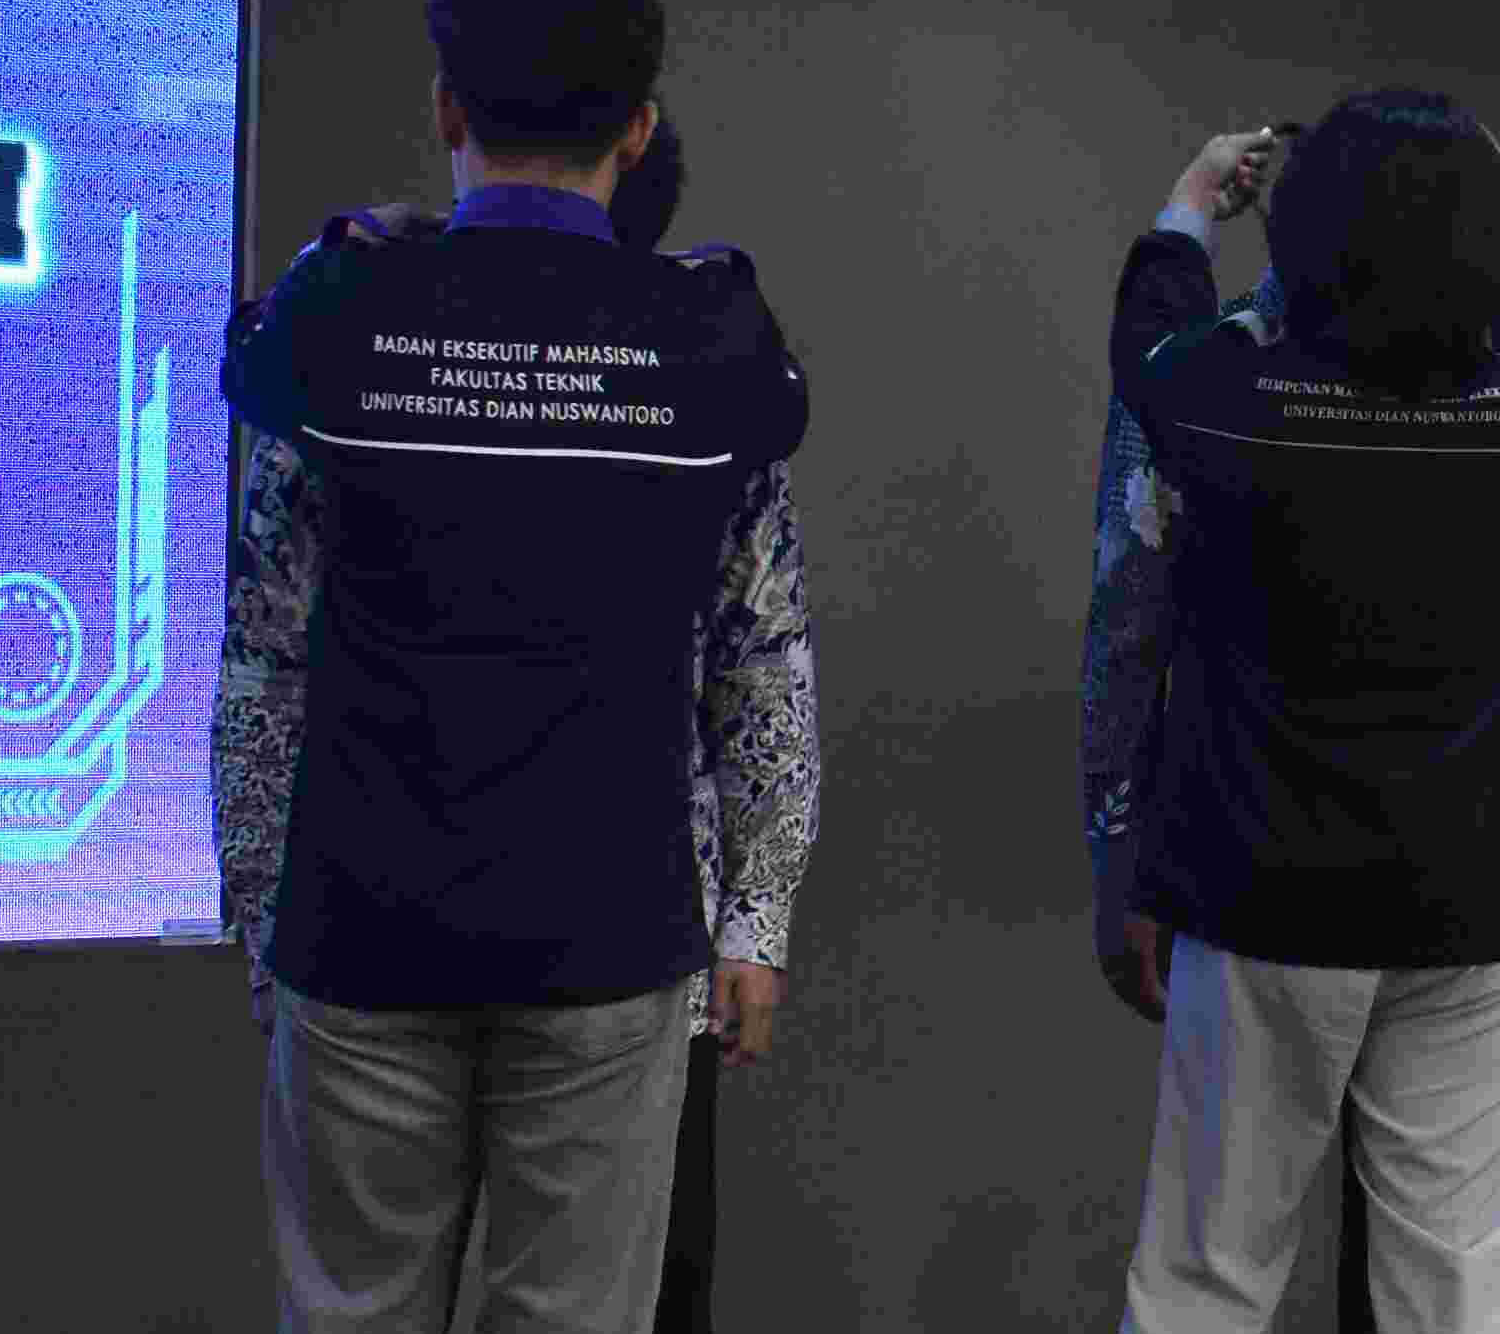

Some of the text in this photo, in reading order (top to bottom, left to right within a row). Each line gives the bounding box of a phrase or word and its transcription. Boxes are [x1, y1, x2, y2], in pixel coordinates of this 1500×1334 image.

[373, 334, 661, 368] BADAN EKSEKUTIF MAHASISWA
[431, 367, 605, 393] FAKULTAS TEKNIK
[361, 392, 675, 426] UNIVERSITAS DIAN NUSWANTORO
[1283, 402, 1373, 422] UNIVERSITAS
